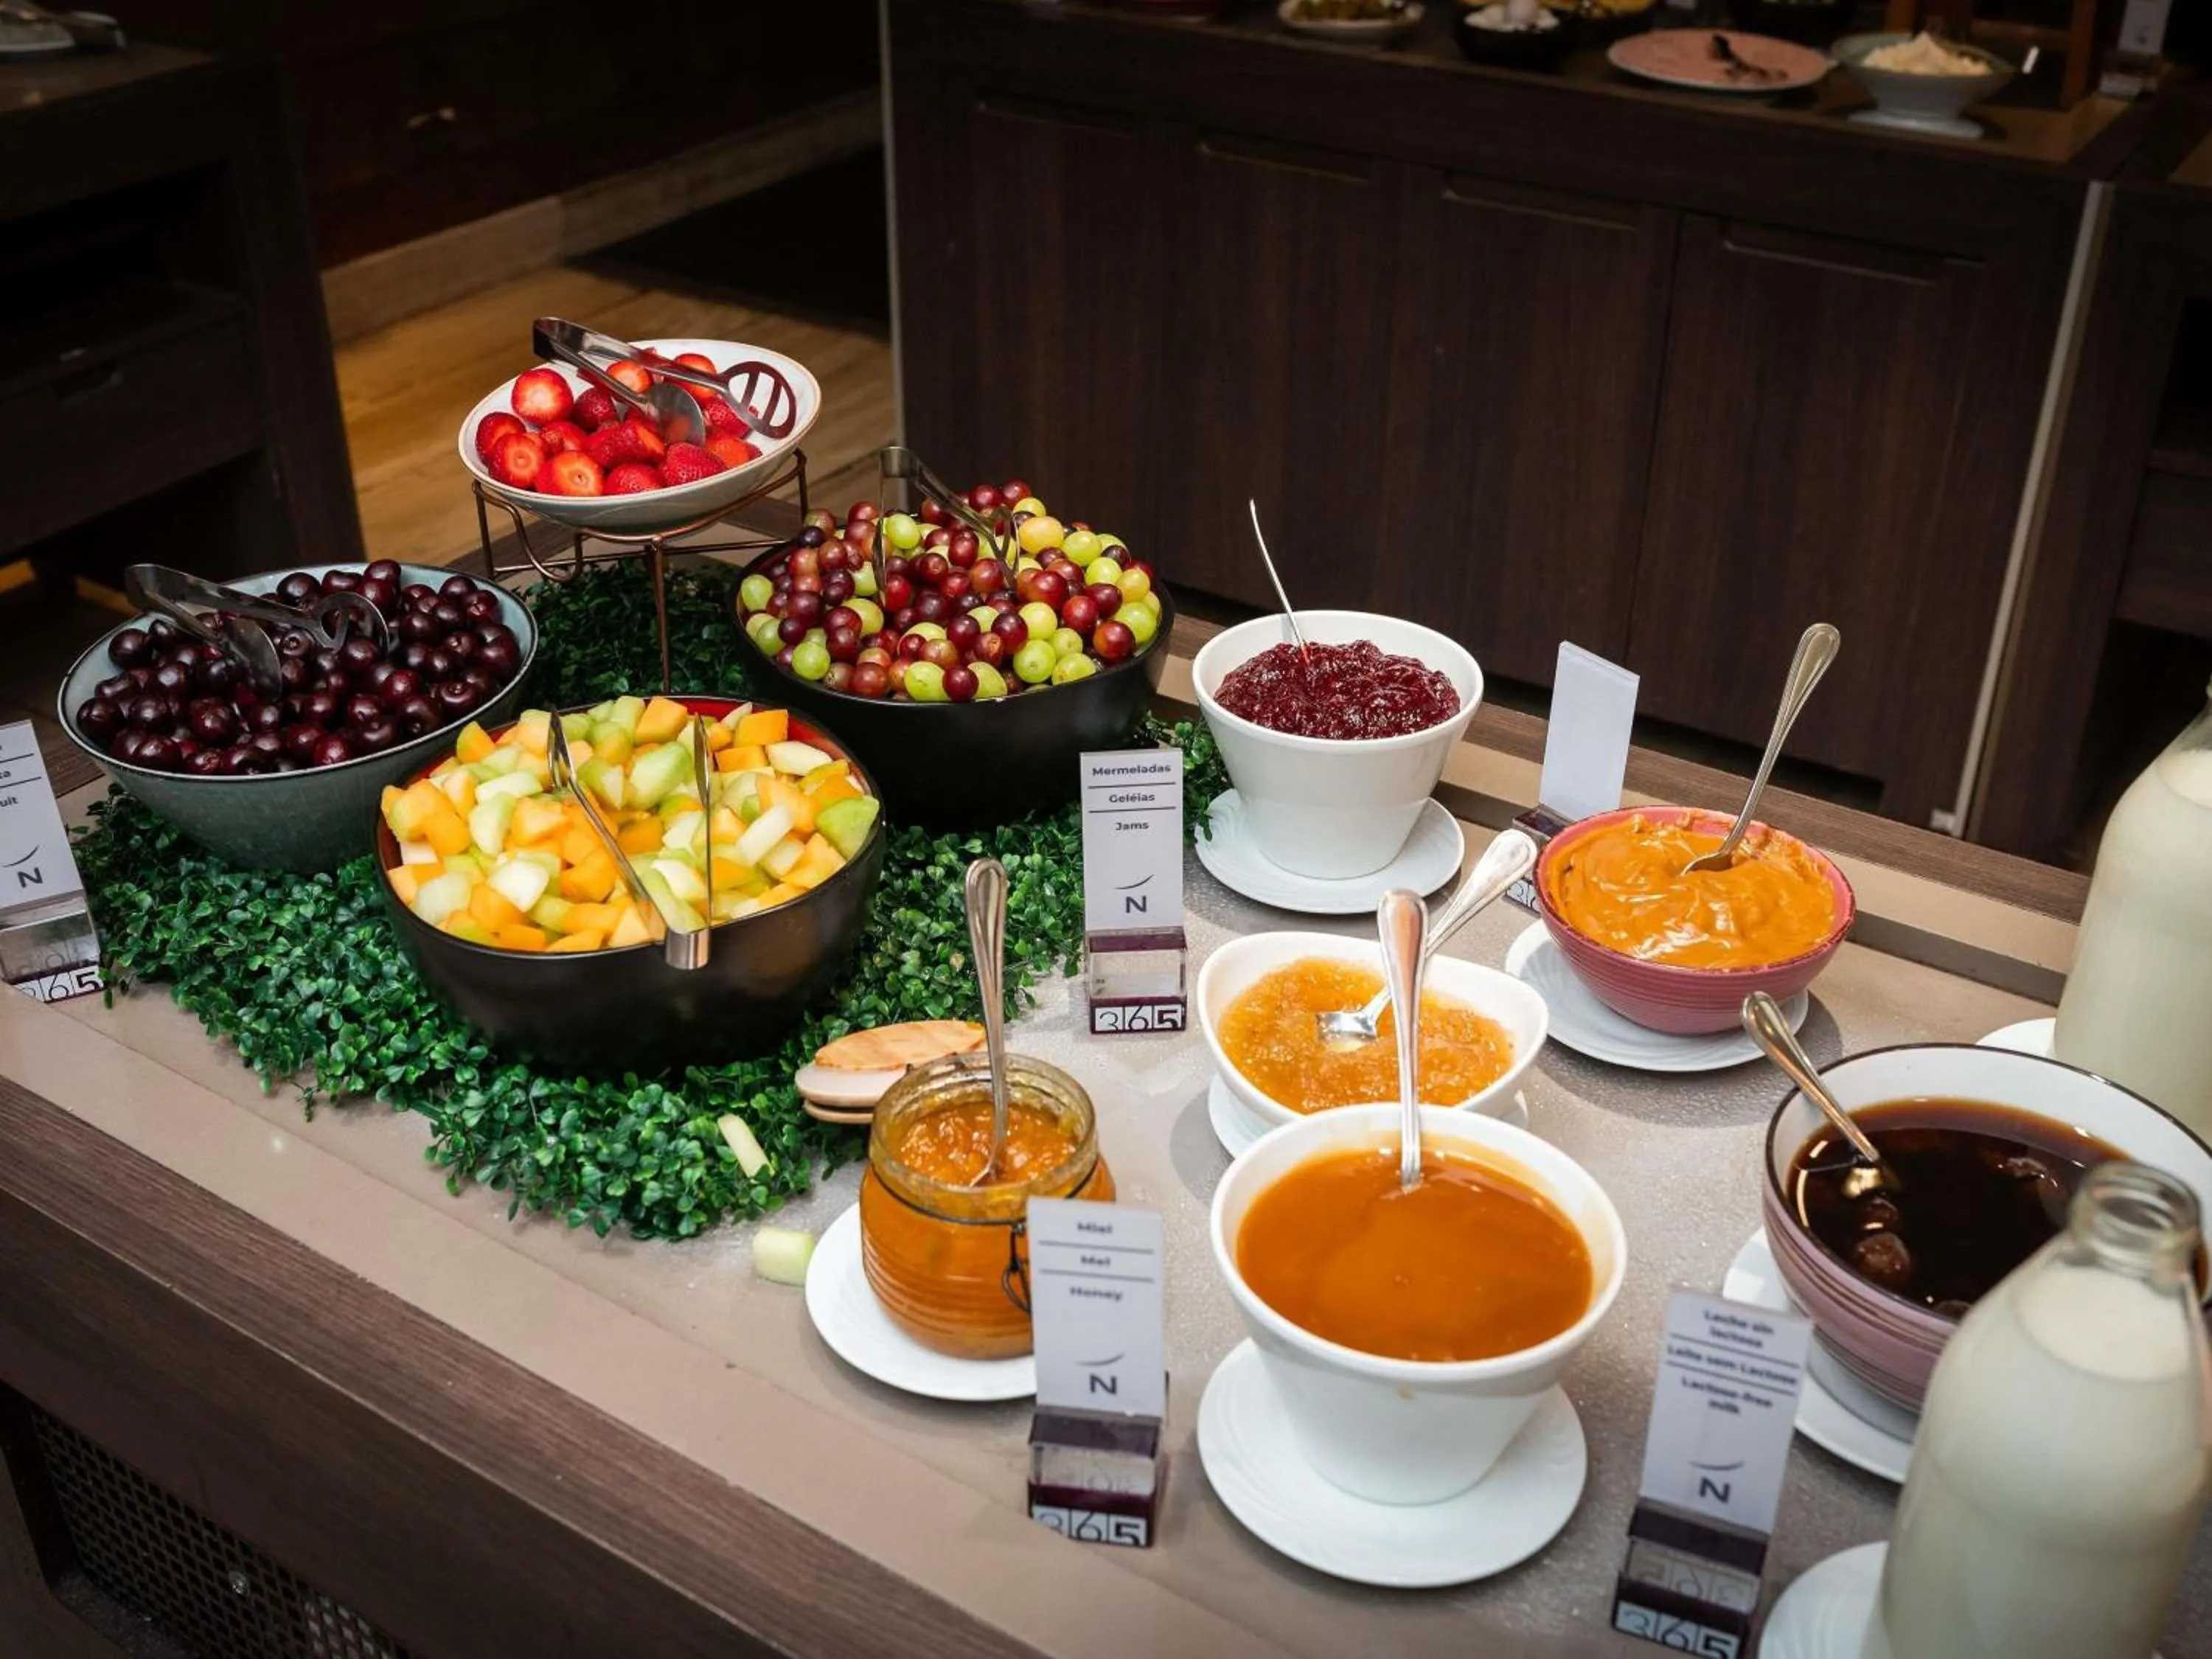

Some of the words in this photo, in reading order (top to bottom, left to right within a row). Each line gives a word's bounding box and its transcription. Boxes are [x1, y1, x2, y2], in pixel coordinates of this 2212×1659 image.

[1092, 764, 1172, 777] Mermeladas
[1108, 793, 1155, 803] Geléias
[1114, 821, 1150, 831] Jams
[18, 867, 44, 888] N
[1126, 894, 1147, 914] N
[1089, 1374, 1118, 1396] N
[1699, 1476, 1731, 1503] N
